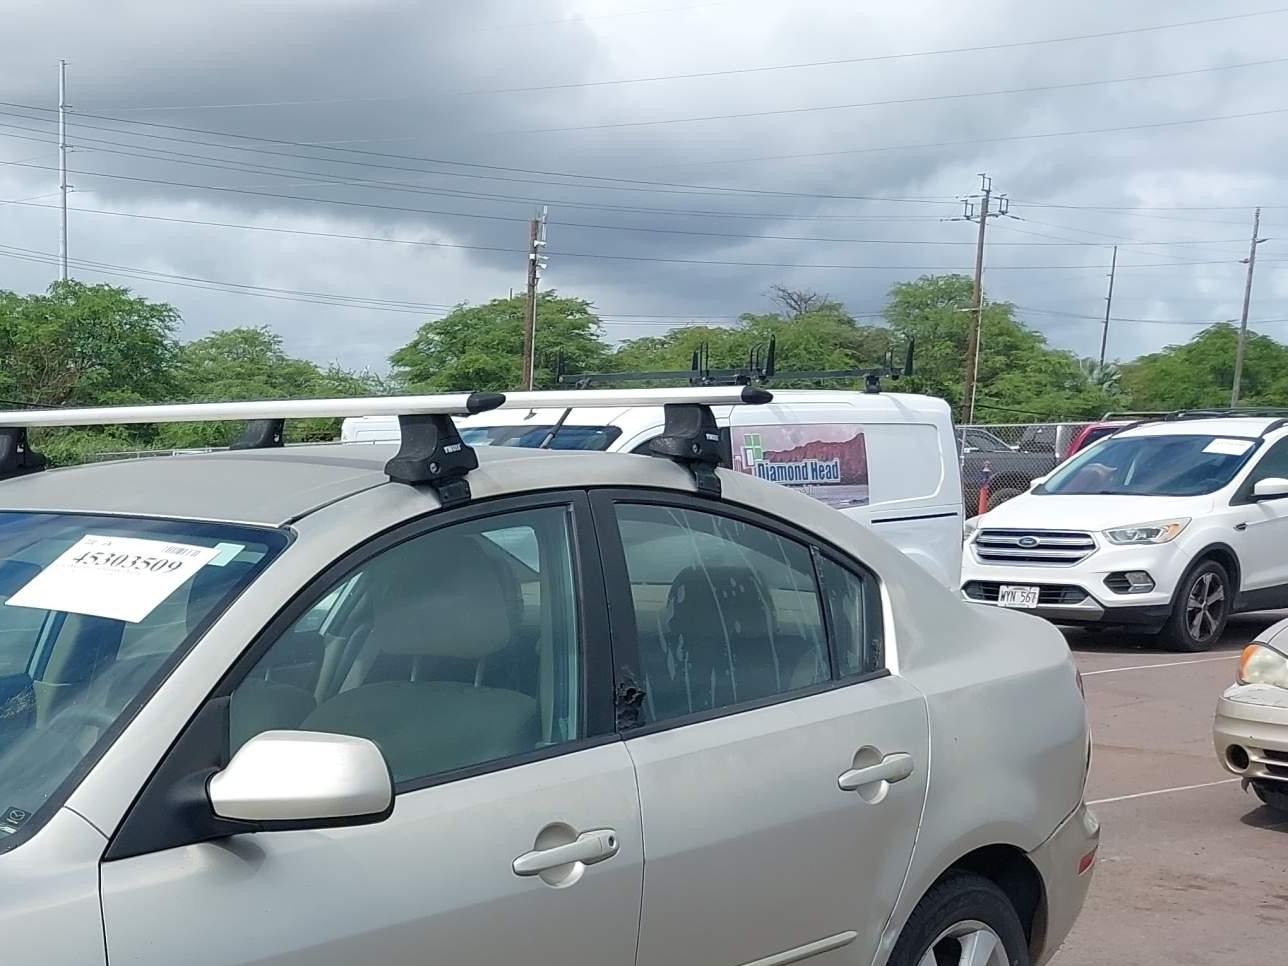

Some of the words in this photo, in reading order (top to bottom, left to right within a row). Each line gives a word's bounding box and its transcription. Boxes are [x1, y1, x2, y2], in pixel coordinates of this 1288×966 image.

[758, 462, 809, 481] Diamond
[811, 460, 839, 480] Head
[73, 551, 183, 574] 45303509
[1021, 591, 1037, 603] 567
